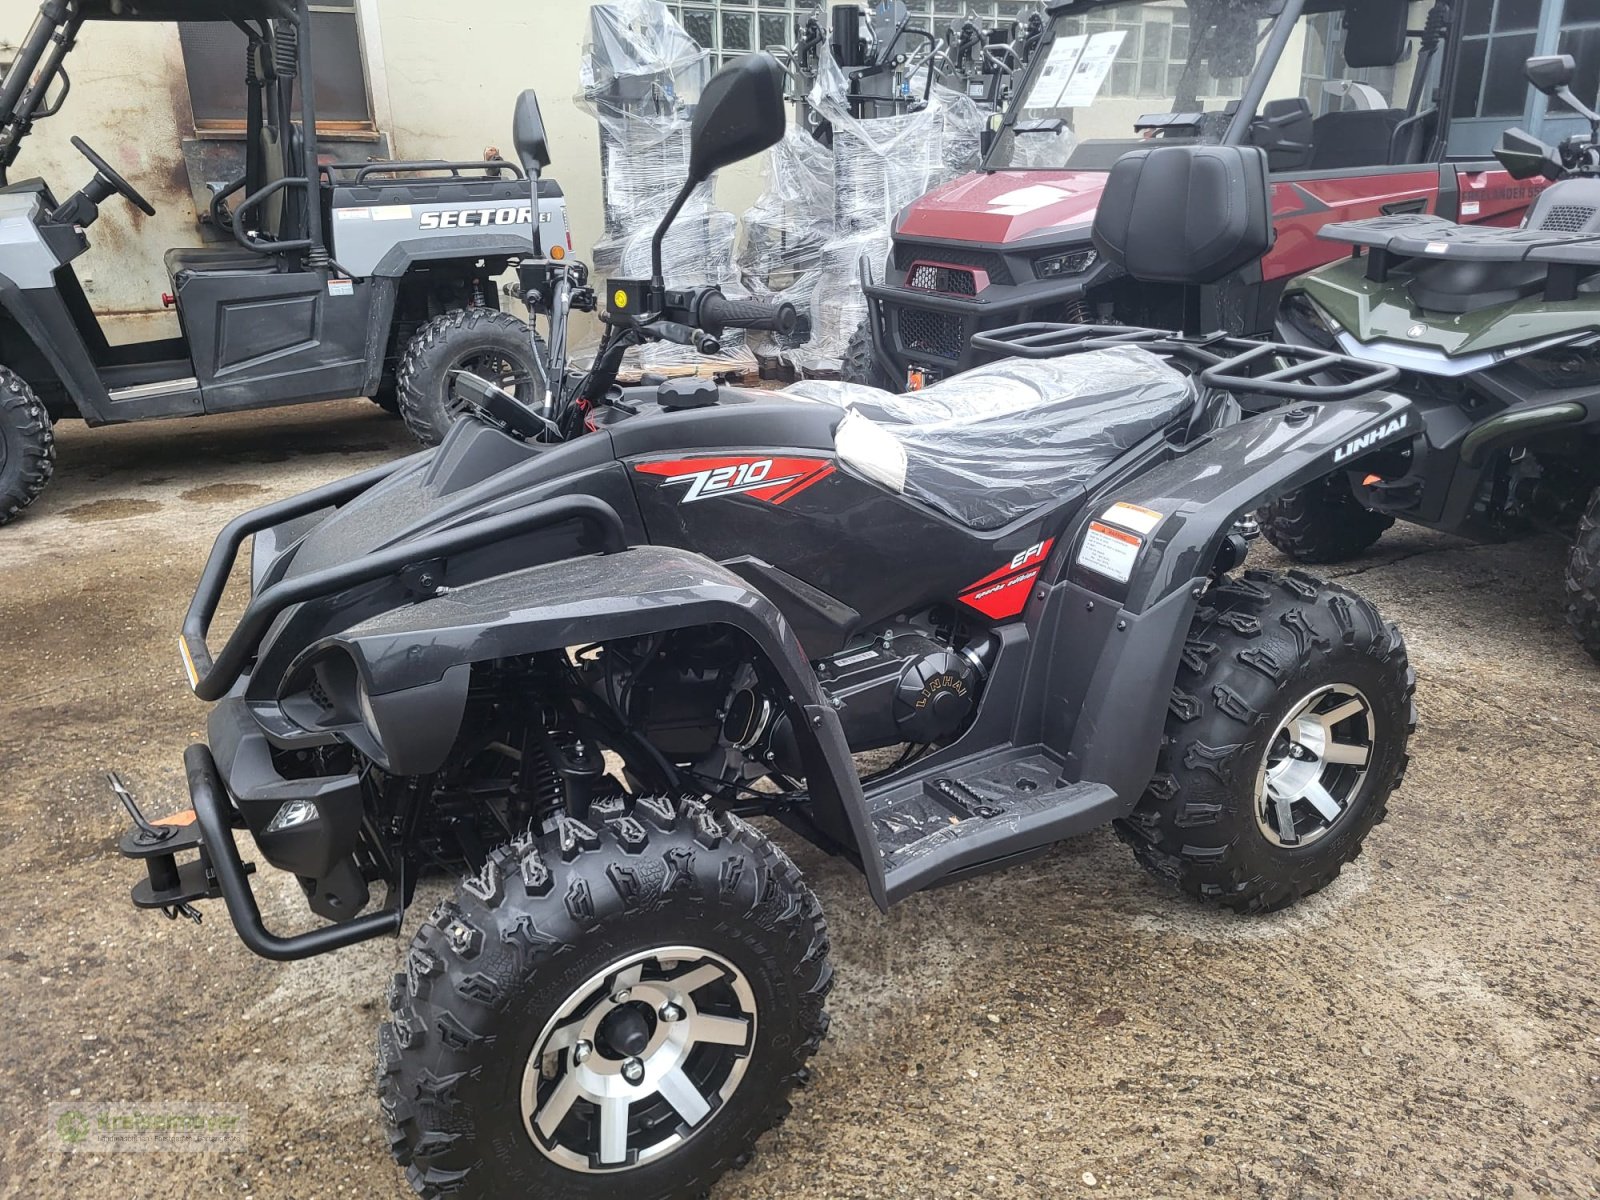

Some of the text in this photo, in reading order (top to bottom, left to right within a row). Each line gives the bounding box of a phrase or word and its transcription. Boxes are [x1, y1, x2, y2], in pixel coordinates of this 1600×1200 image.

[419, 205, 533, 231] SECTOR
[1333, 412, 1409, 463] LINHAI
[663, 458, 786, 504] Z210
[1010, 540, 1045, 570] EFI
[915, 675, 967, 708] LINHAI
